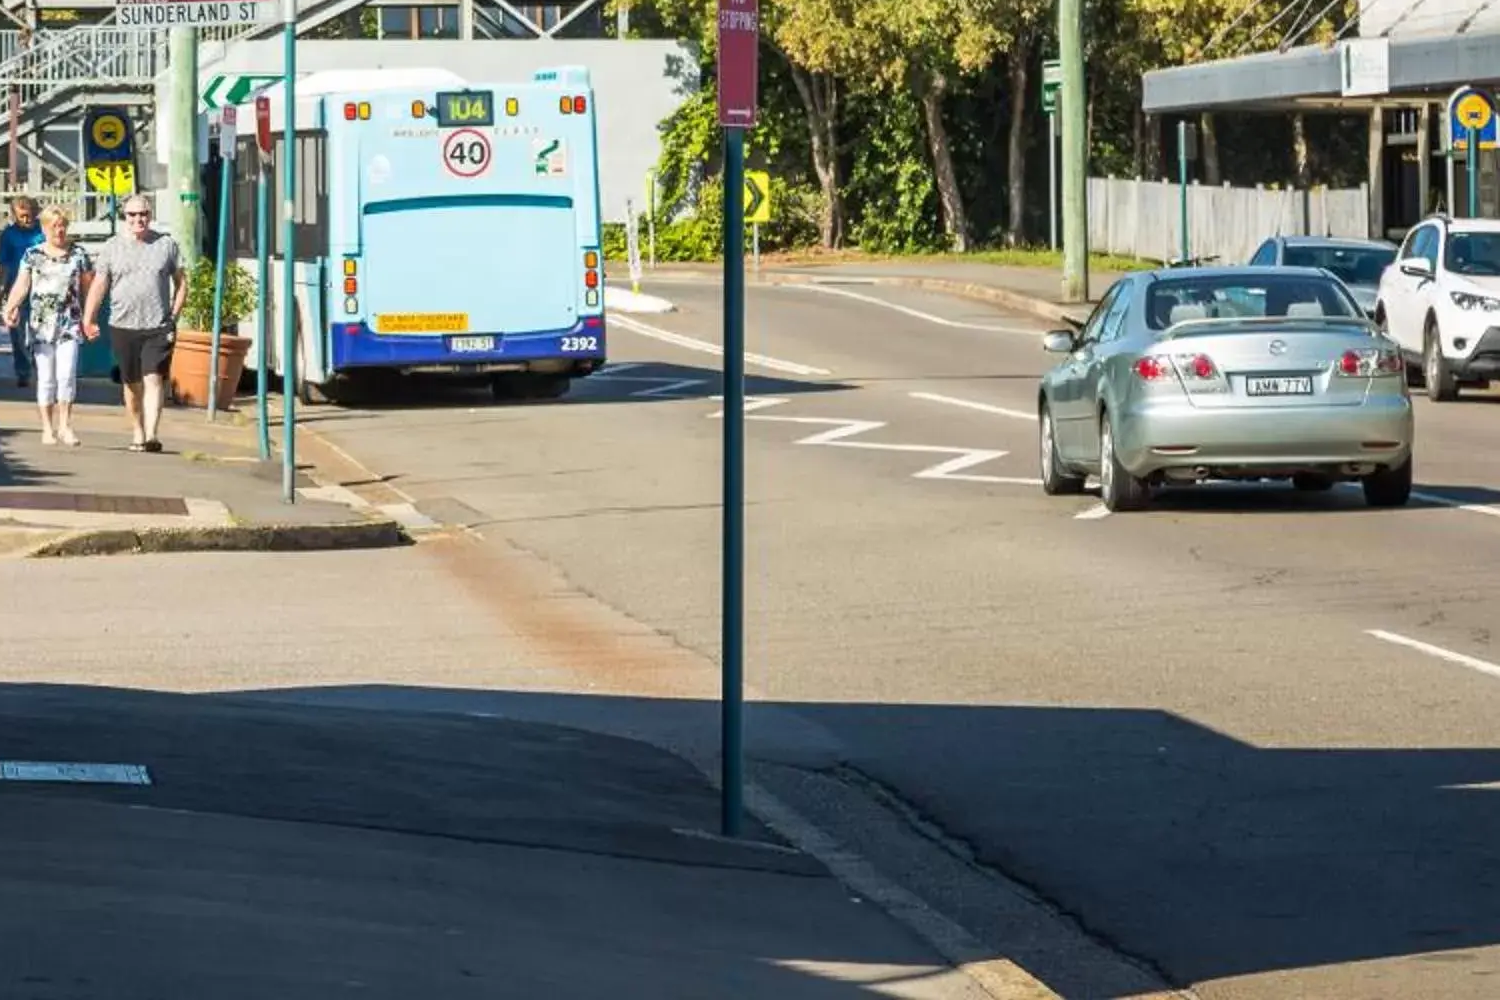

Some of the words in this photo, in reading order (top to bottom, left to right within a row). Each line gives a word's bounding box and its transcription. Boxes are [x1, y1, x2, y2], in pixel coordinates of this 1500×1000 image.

[121, 3, 230, 25] SUNDERLAND
[239, 2, 257, 21] ST
[449, 96, 486, 120] 104
[450, 141, 485, 164] 40
[560, 336, 598, 351] 2392
